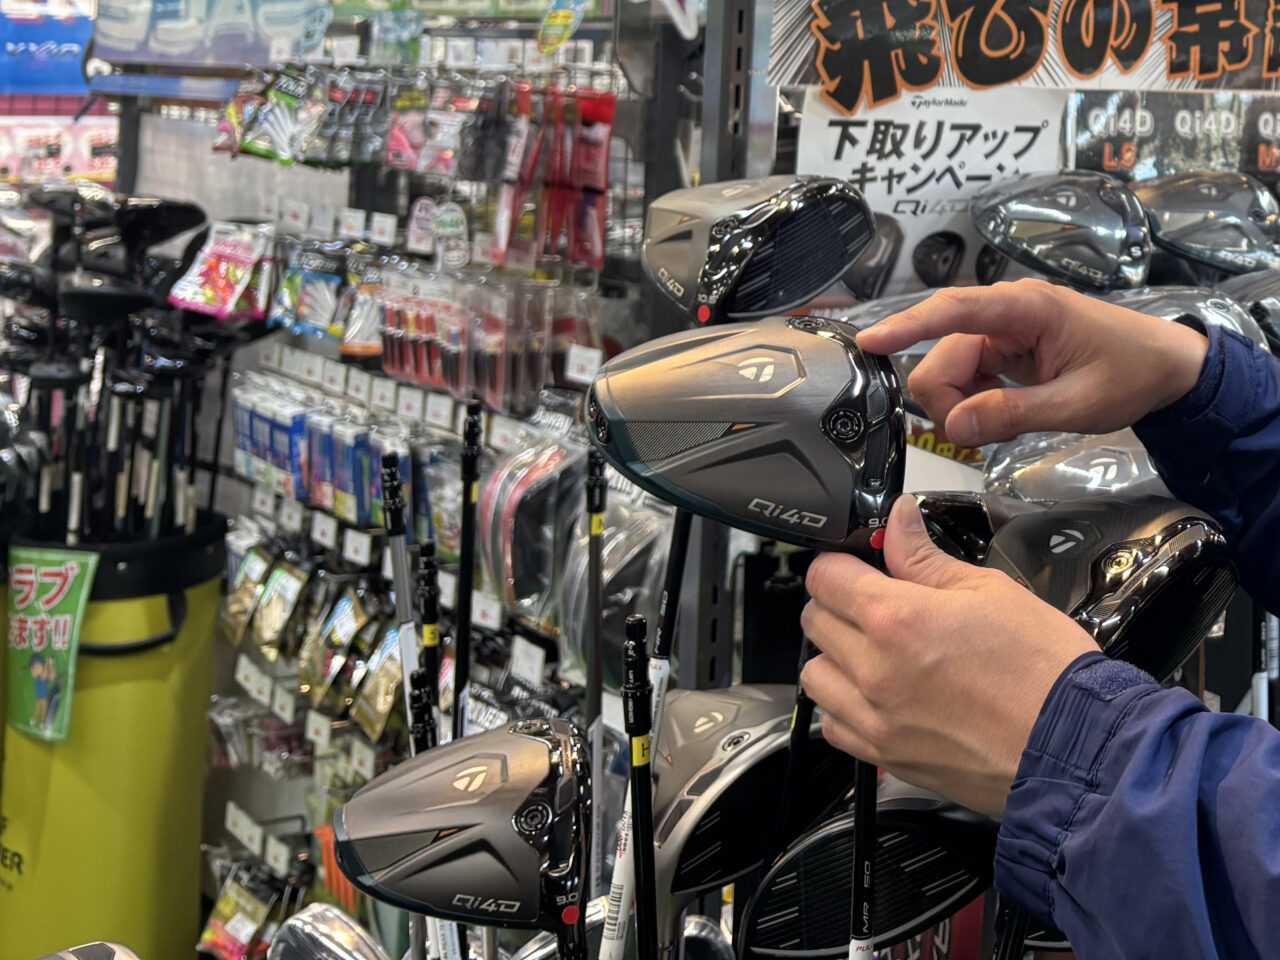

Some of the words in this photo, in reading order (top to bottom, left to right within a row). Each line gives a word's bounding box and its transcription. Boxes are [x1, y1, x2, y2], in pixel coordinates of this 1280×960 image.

[911, 95, 968, 110] TaylorMade
[1088, 107, 1154, 137] Qi4D
[1174, 109, 1236, 138] Qi4D
[828, 119, 1049, 161] 下取りアップ
[748, 498, 828, 528] Qi4D
[452, 893, 521, 913] Qi4D
[556, 892, 579, 906] 9.0
